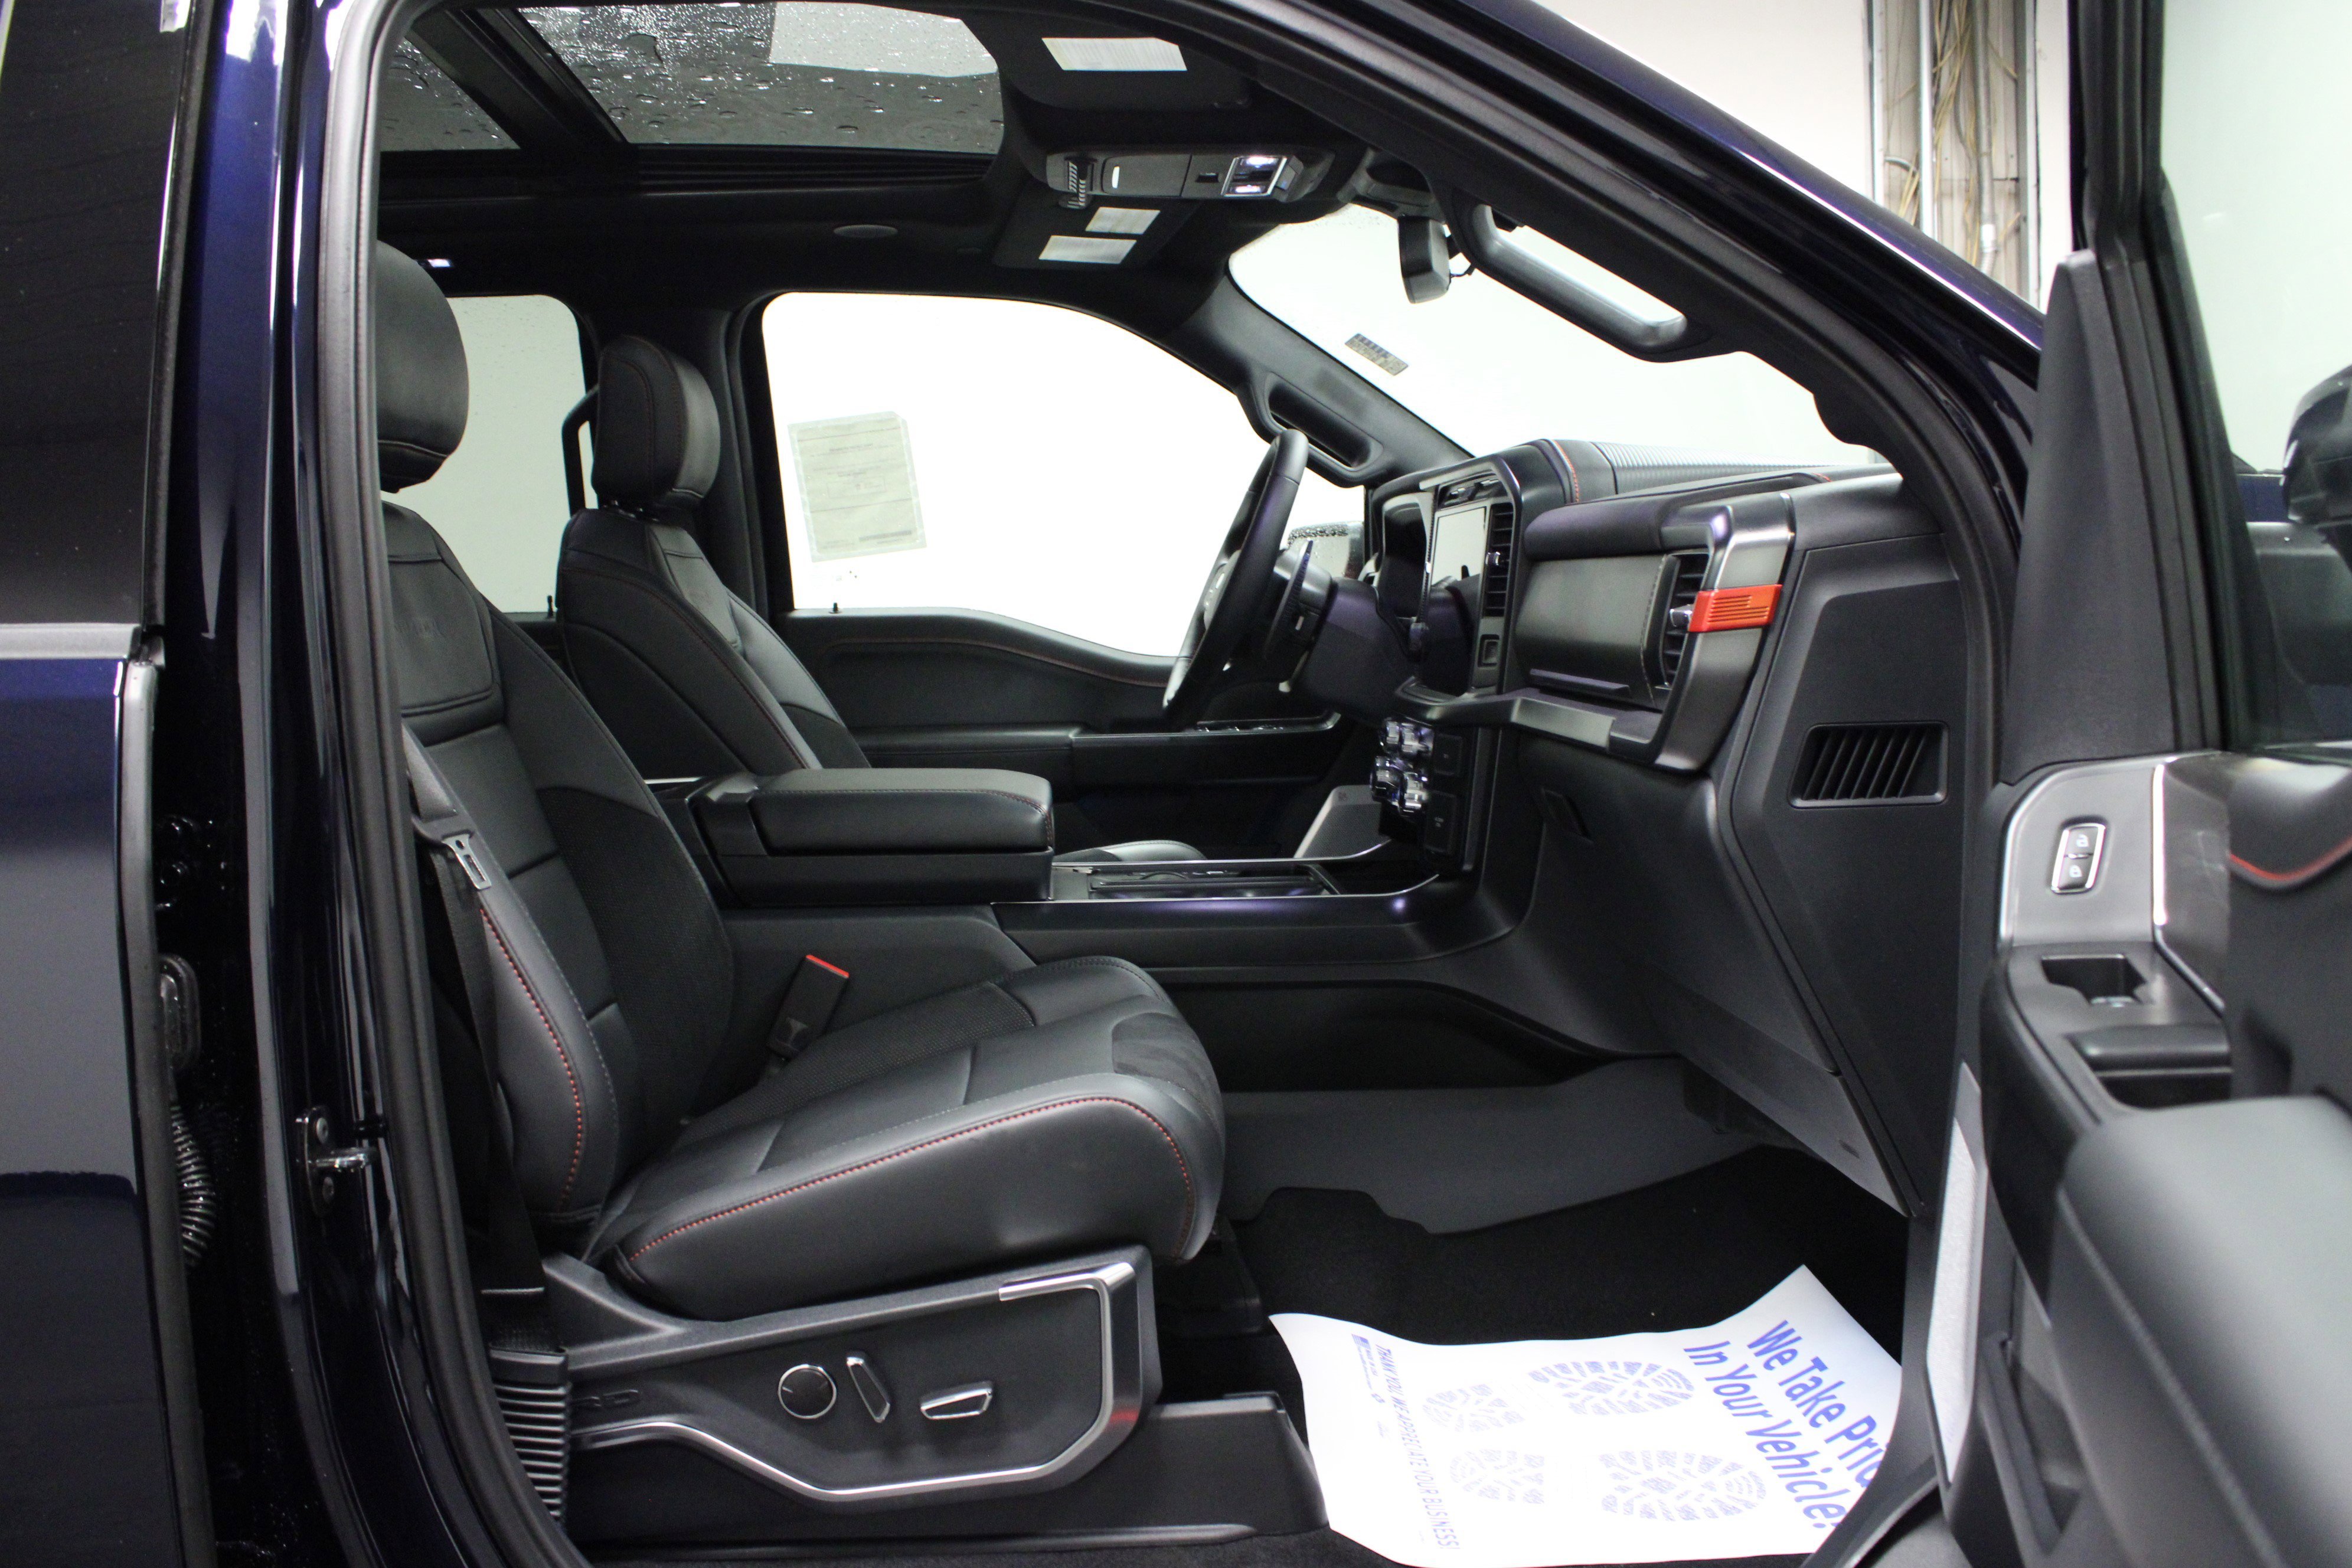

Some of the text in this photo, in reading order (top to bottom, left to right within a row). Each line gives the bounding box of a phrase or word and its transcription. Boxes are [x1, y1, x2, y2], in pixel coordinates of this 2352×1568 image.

[1376, 1344, 1398, 1376] THANK
[1683, 1340, 1732, 1366] In
[1391, 1396, 1410, 1414] WE
[1704, 1363, 1775, 1417] Your
[1747, 1319, 1887, 1488] We Take Pri
[1396, 1411, 1429, 1467] APPRECIATE
[1412, 1470, 1439, 1495] YOUR
